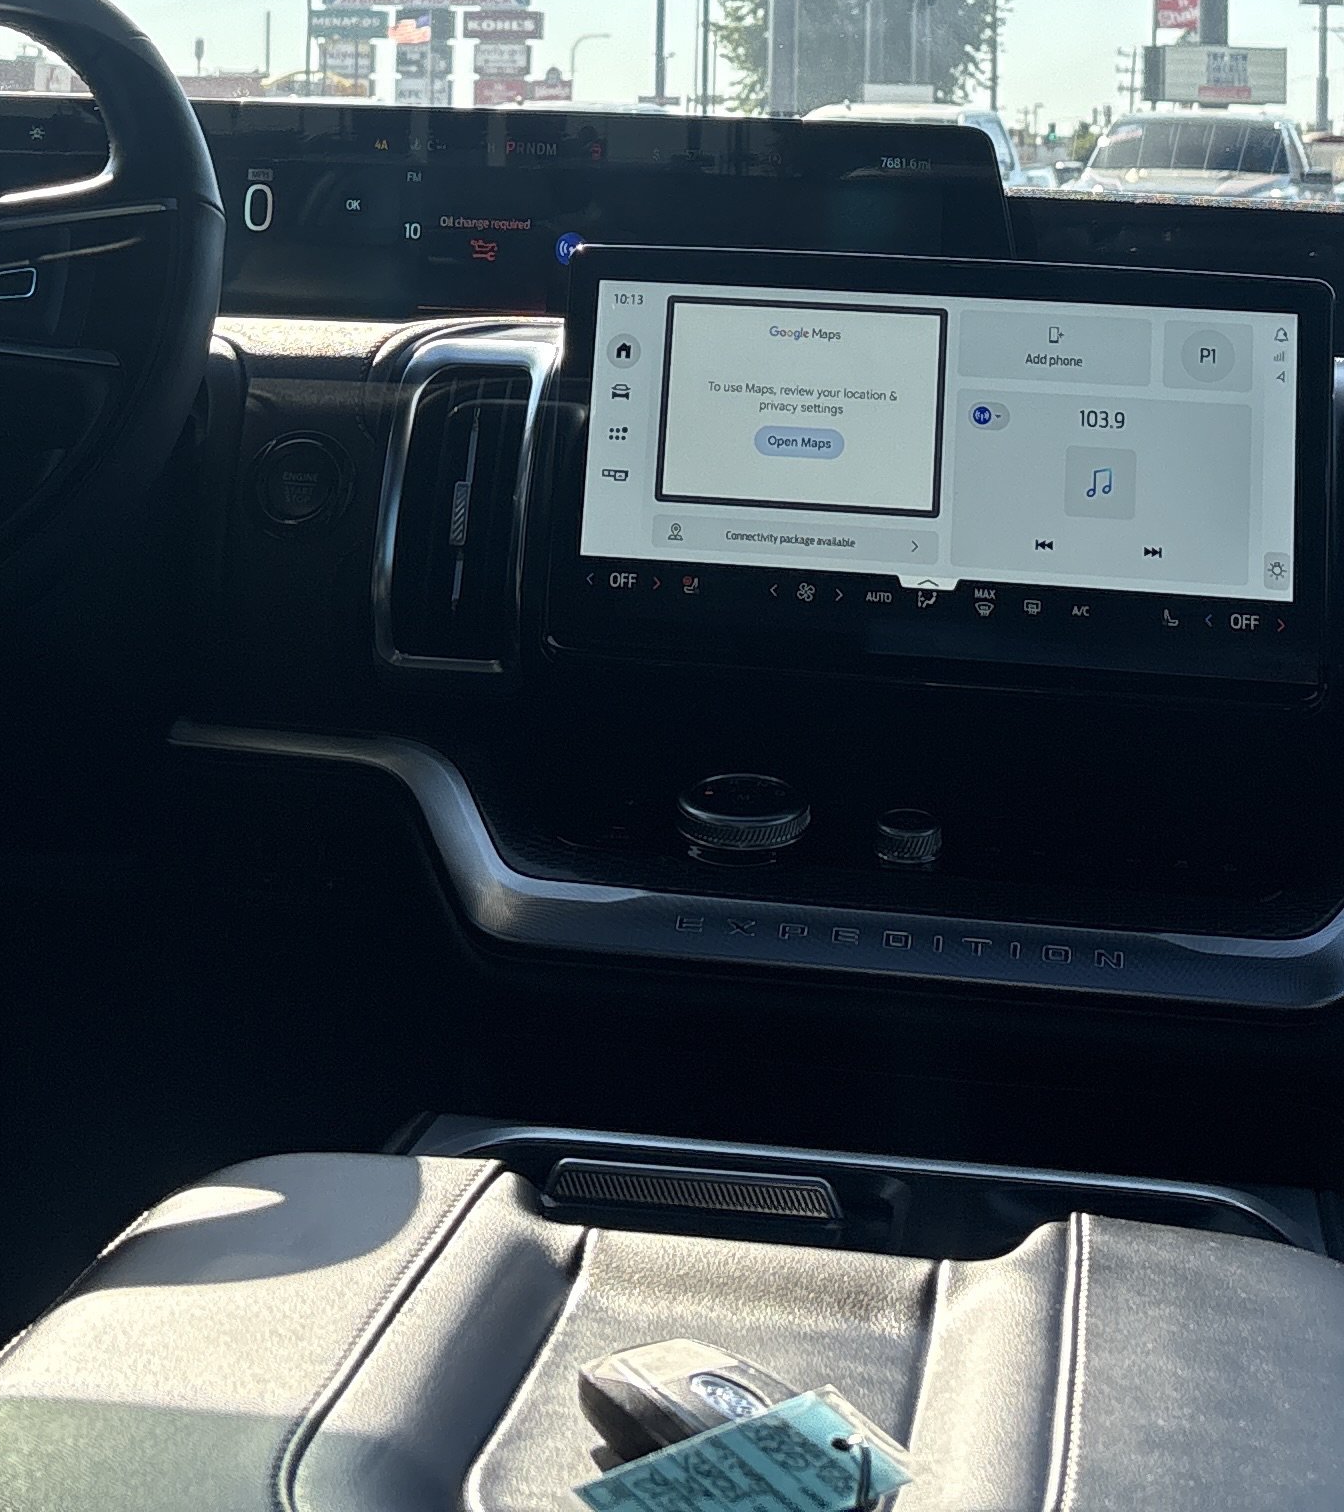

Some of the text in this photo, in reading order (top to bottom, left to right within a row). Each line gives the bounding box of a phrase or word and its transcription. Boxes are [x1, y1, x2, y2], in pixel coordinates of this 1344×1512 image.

[467, 19, 535, 32] KOHL'S
[881, 156, 917, 169] 7681.6
[244, 183, 274, 232] 0
[346, 199, 361, 211] OK
[440, 215, 531, 231] Oil change required
[404, 223, 421, 240] 10
[613, 293, 644, 306] 10:13
[769, 326, 842, 341] Google Maps
[1025, 353, 1083, 368] Add phone
[1199, 347, 1217, 365] P1
[708, 381, 898, 402] To use Maps, review your location &
[758, 400, 844, 416] privacy settings
[1079, 409, 1126, 429] 103.9
[767, 435, 832, 450] Open Maps
[725, 530, 856, 548] Connectivity package available
[609, 573, 638, 588] OFF
[865, 591, 893, 604] AUTO
[974, 588, 997, 600] MAX
[1072, 605, 1090, 617] A/C
[1230, 613, 1260, 630] OFF
[674, 915, 1126, 971] EXPEDITION
